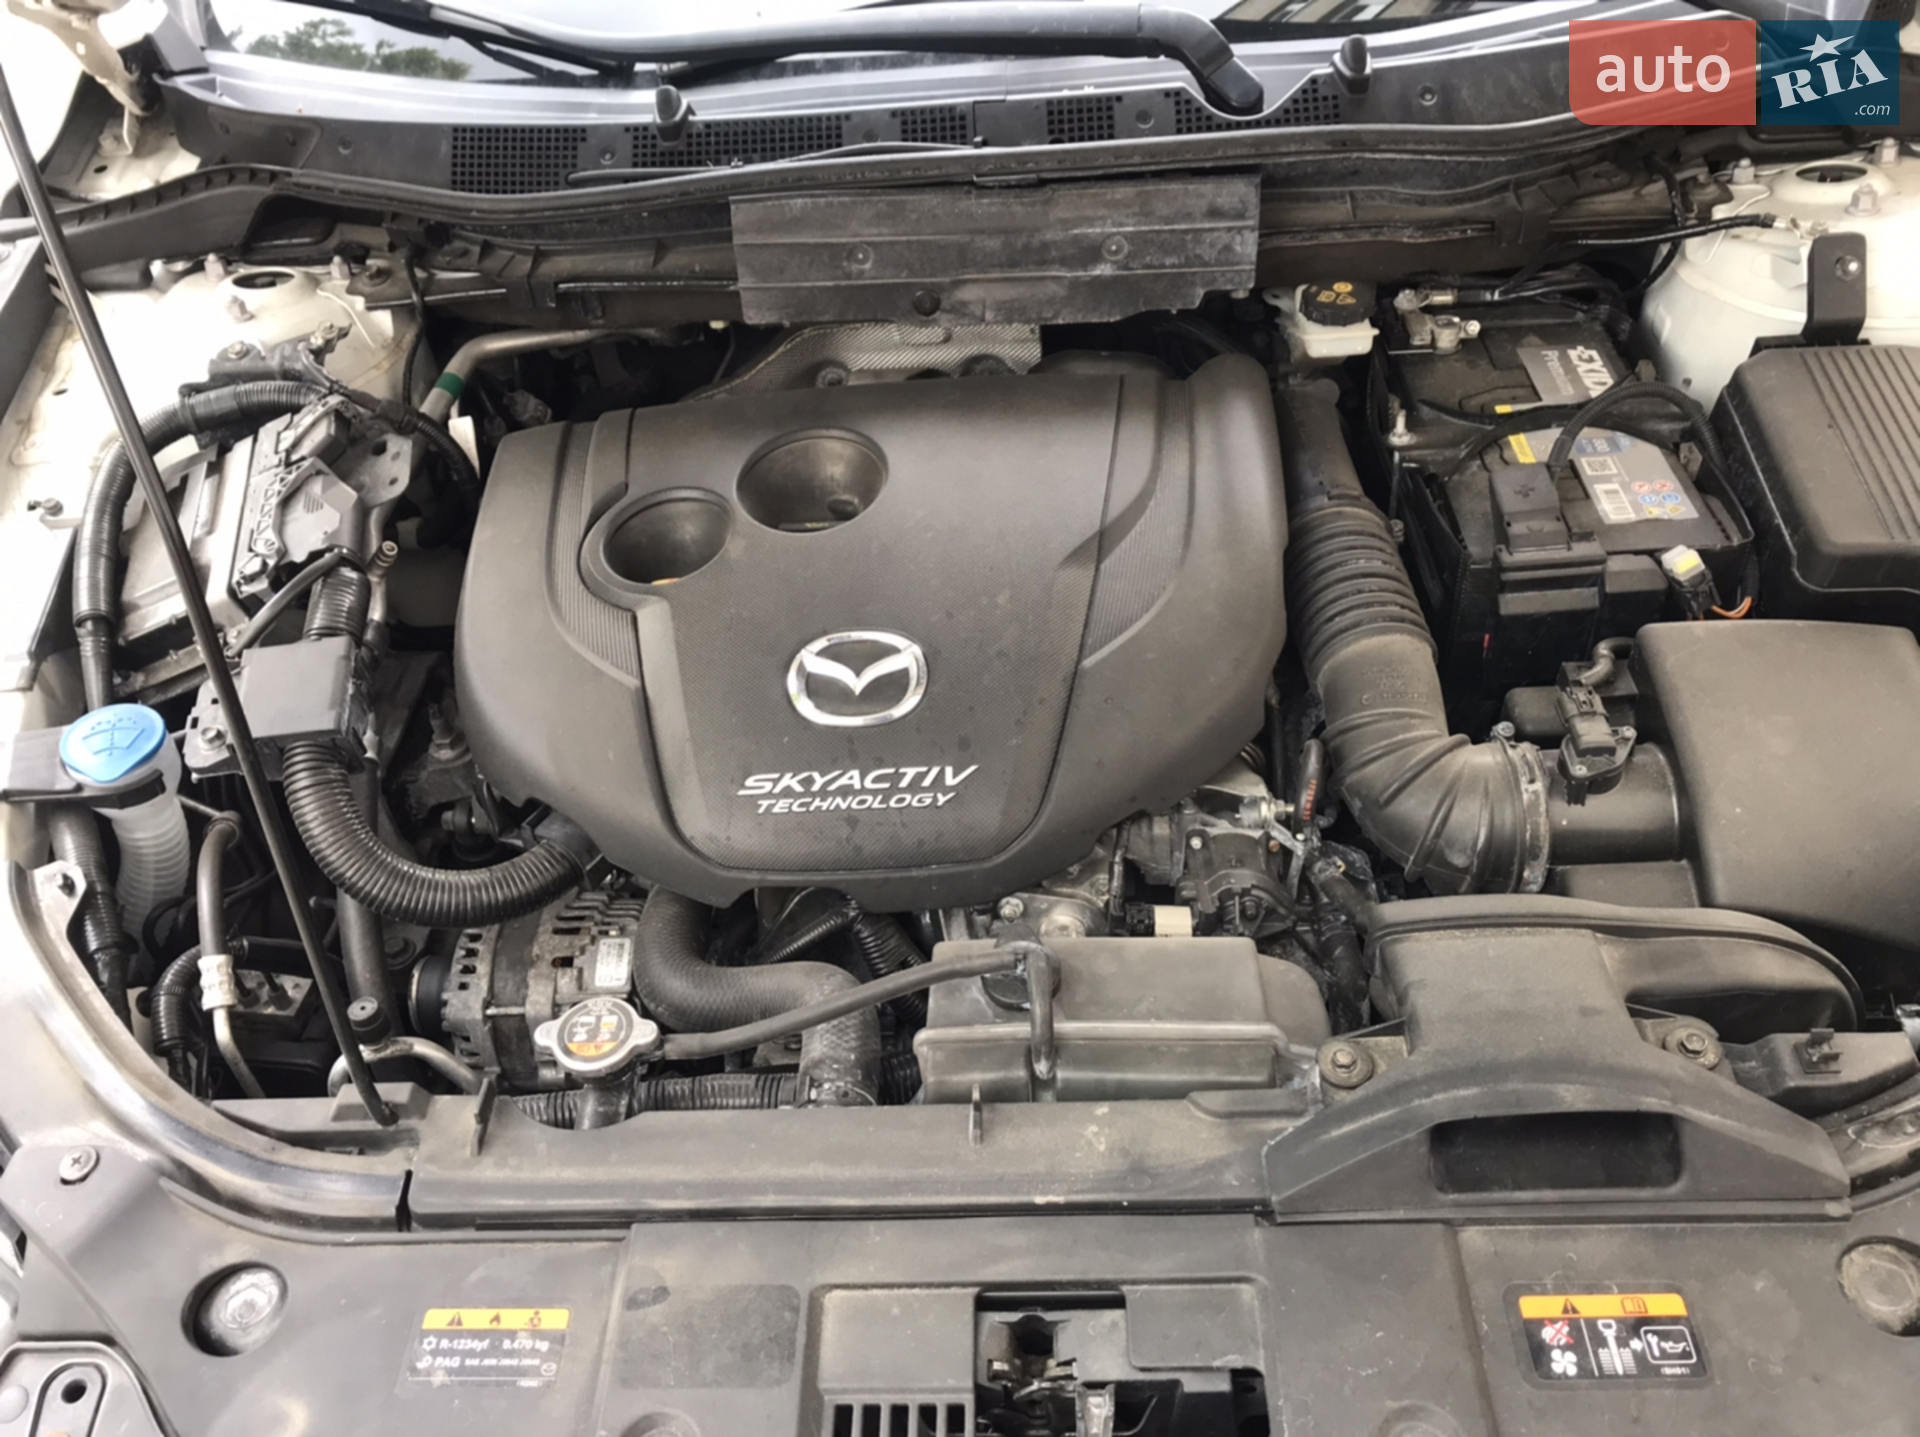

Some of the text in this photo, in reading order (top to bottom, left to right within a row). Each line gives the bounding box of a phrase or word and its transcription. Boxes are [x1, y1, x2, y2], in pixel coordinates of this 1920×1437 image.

[1541, 349, 1575, 395] Premium
[737, 764, 979, 796] SKYACTIV
[757, 791, 957, 815] TECHNOLOGY
[438, 1338, 490, 1352] R-1234yf
[535, 1339, 550, 1352] kg
[434, 1356, 461, 1368] PAG
